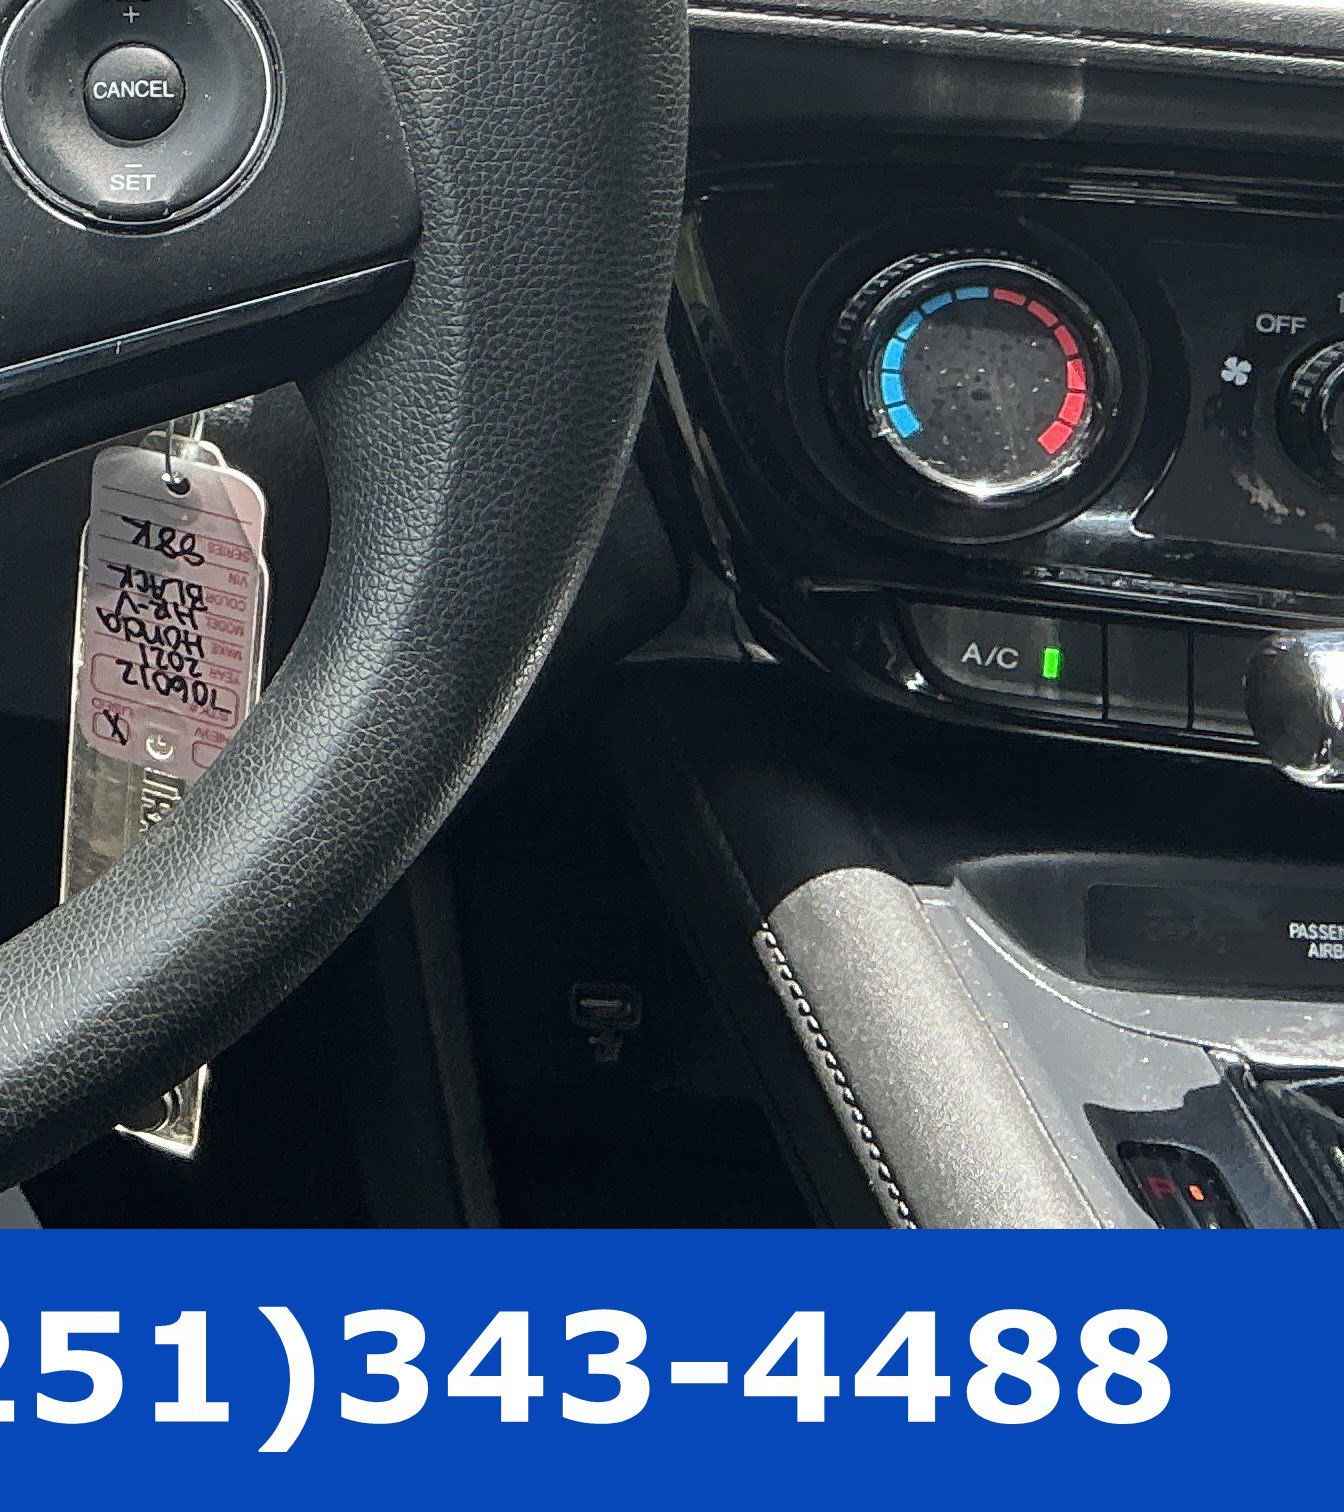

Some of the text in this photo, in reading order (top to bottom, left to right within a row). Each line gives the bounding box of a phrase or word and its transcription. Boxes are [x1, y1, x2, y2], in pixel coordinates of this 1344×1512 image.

[92, 79, 175, 101] CANCEL
[109, 173, 157, 192] SET
[1255, 313, 1308, 335] OFF
[106, 564, 208, 612] BLACK
[961, 640, 1019, 672] A/C
